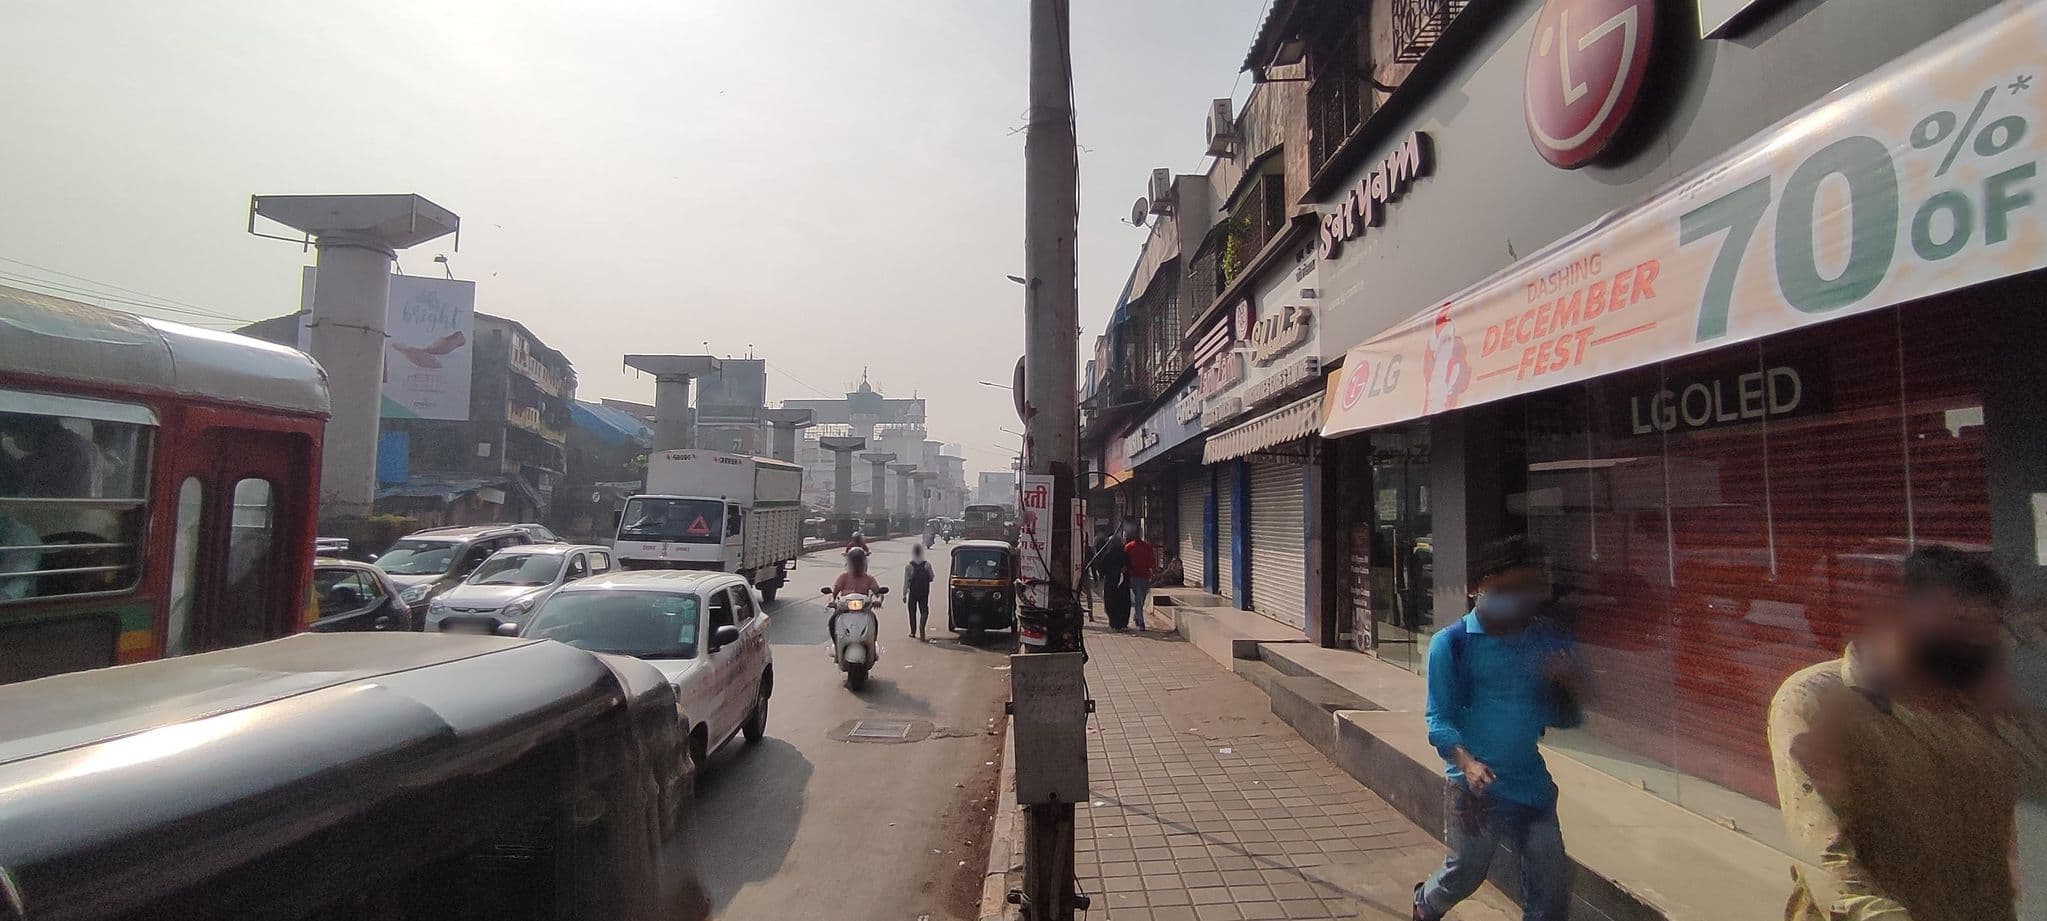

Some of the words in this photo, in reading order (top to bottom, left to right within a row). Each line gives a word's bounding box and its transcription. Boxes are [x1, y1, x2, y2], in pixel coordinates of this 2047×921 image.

[1527, 253, 1602, 304] DASHING
[1481, 259, 1661, 359] DECEMBER
[1367, 353, 1402, 398] LG
[1516, 326, 1596, 381] FEST
